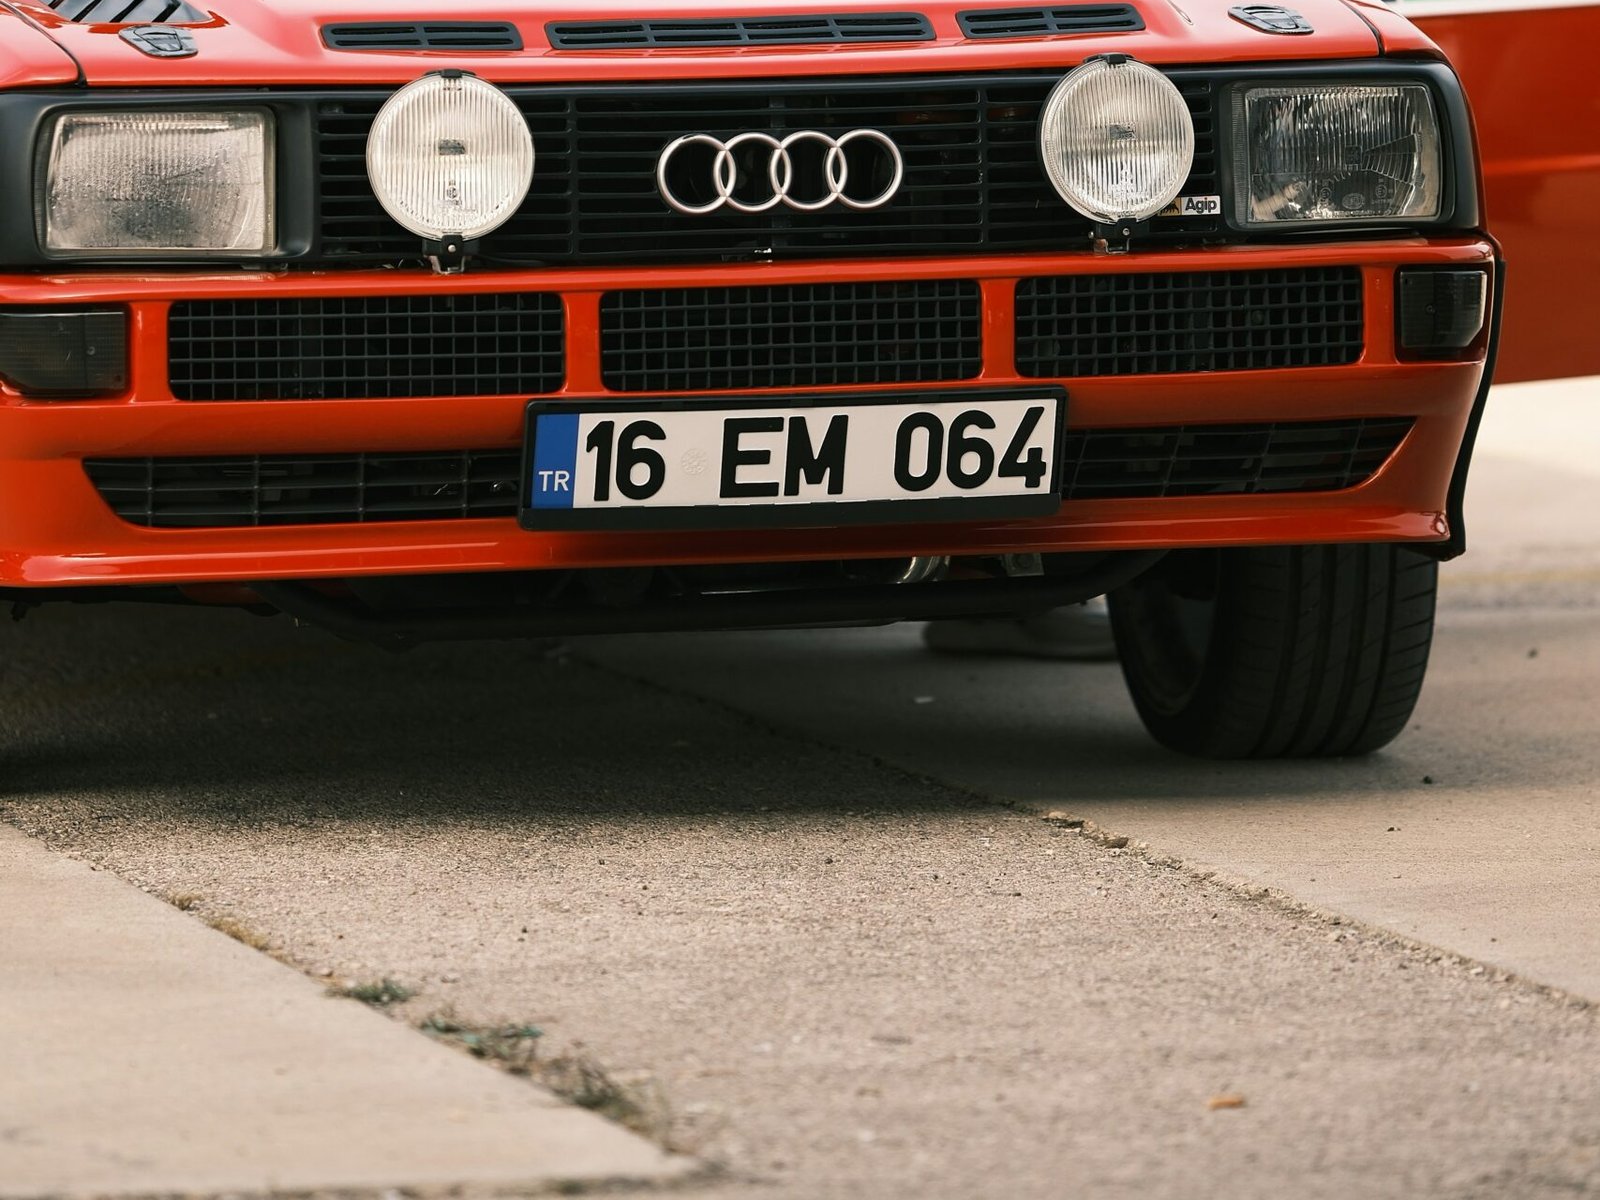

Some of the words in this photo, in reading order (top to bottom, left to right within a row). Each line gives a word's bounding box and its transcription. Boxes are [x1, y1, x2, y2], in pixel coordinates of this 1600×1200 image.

[1184, 197, 1218, 214] Agip
[585, 419, 667, 502] 16
[718, 413, 848, 499] EM
[892, 406, 1047, 492] 064
[538, 469, 569, 492] TR
